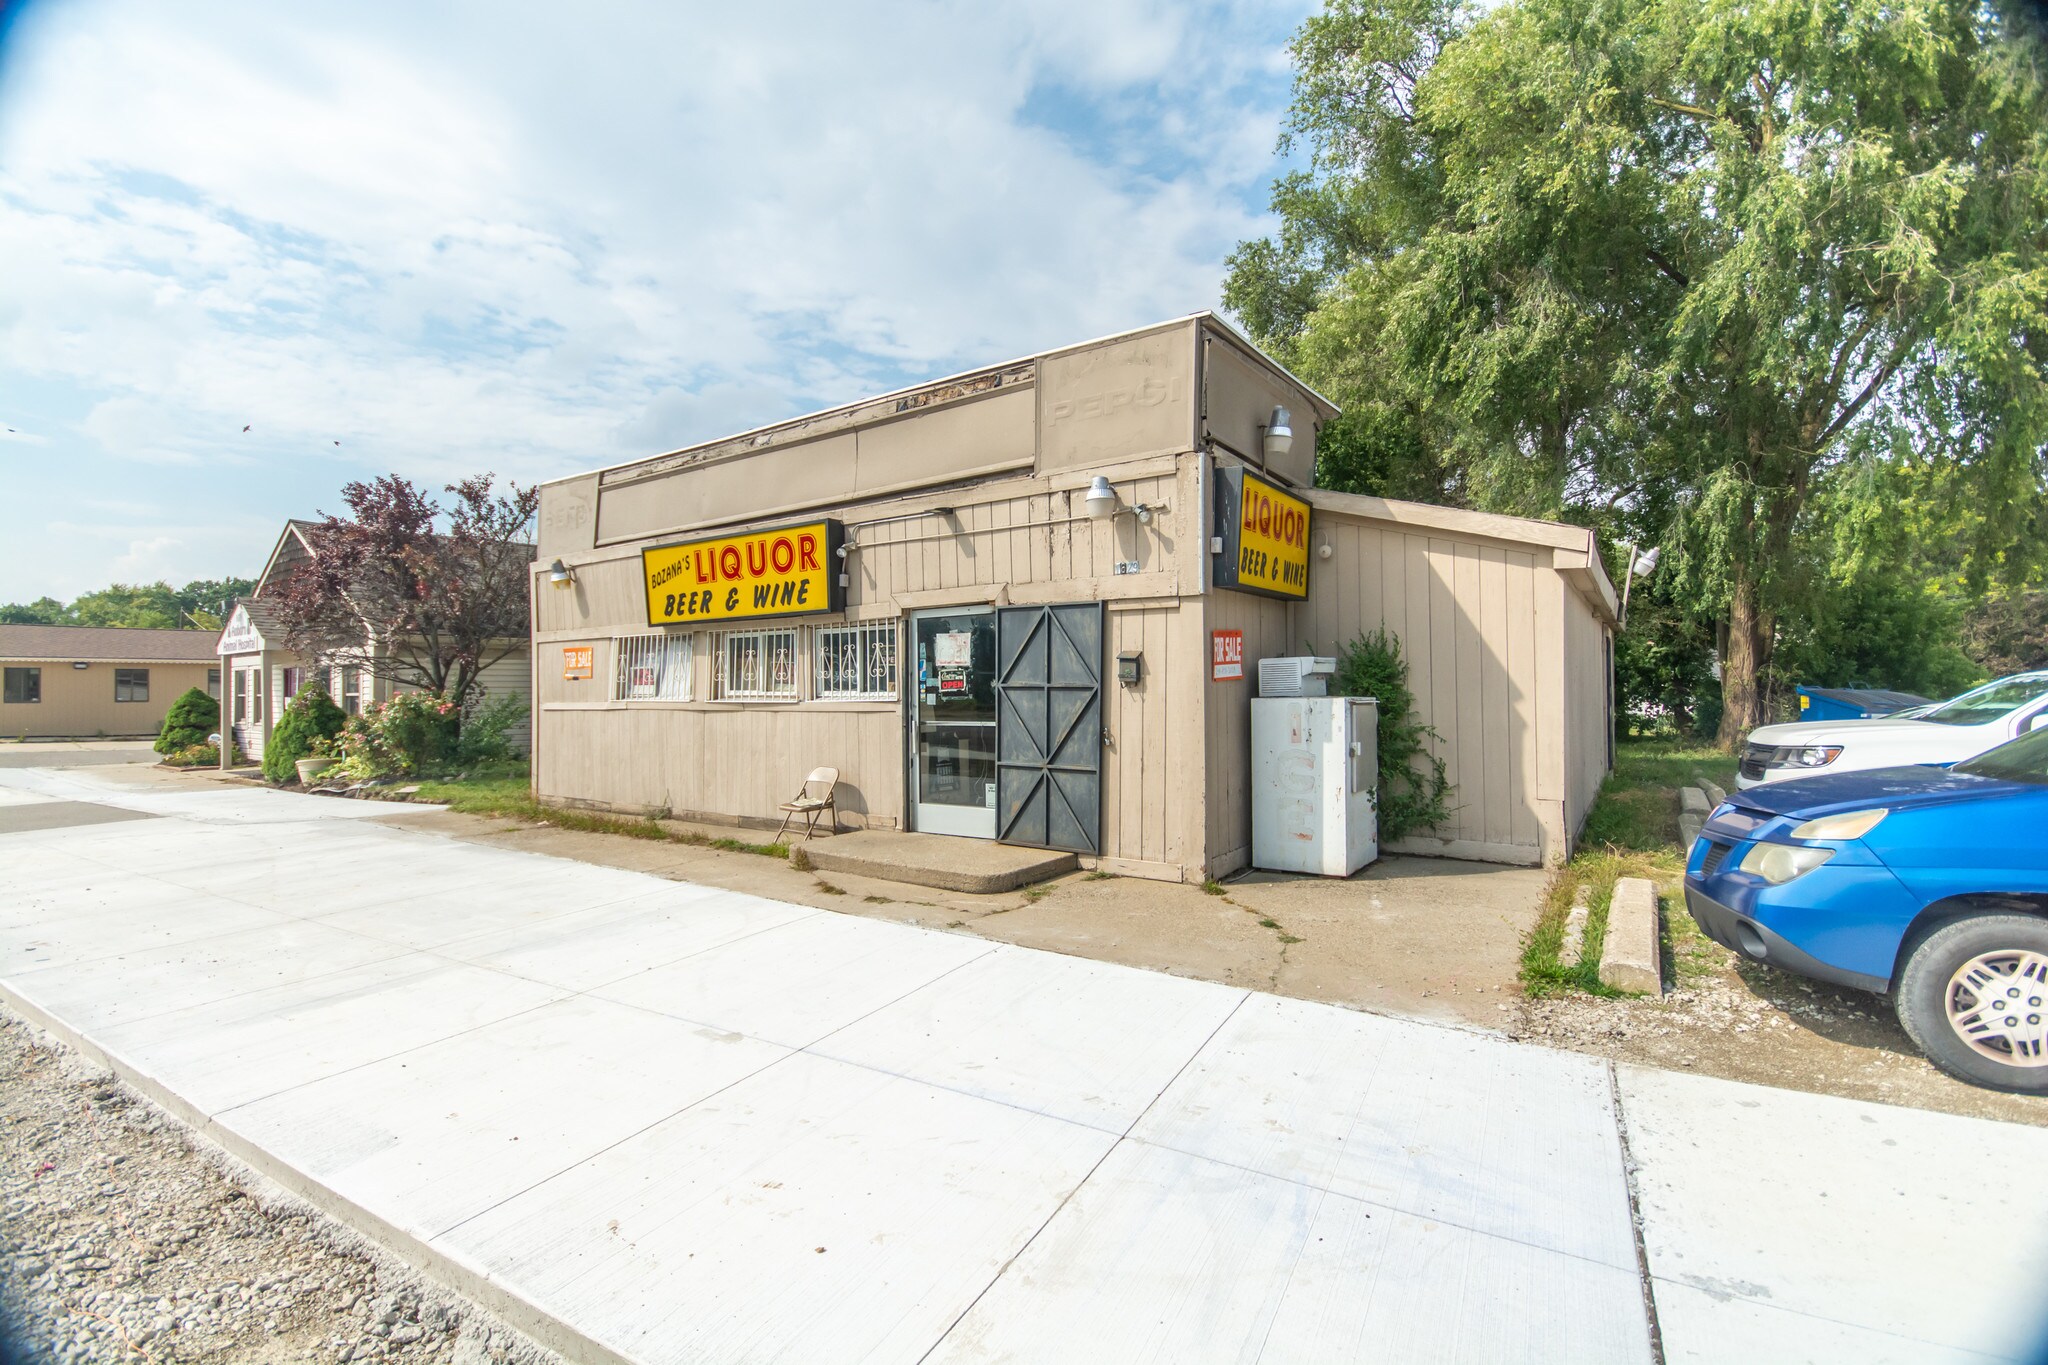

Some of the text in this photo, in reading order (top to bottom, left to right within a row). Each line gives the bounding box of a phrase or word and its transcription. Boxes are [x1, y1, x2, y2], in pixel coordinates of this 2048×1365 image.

[1244, 487, 1304, 550] LIQUOR
[651, 533, 821, 589] BOZANA'S LIQUOR
[1241, 546, 1304, 588] BEER & WINE
[664, 579, 810, 617] BEER & WINE
[565, 651, 592, 668] FOR SALE
[1214, 637, 1242, 662] FOR SALE
